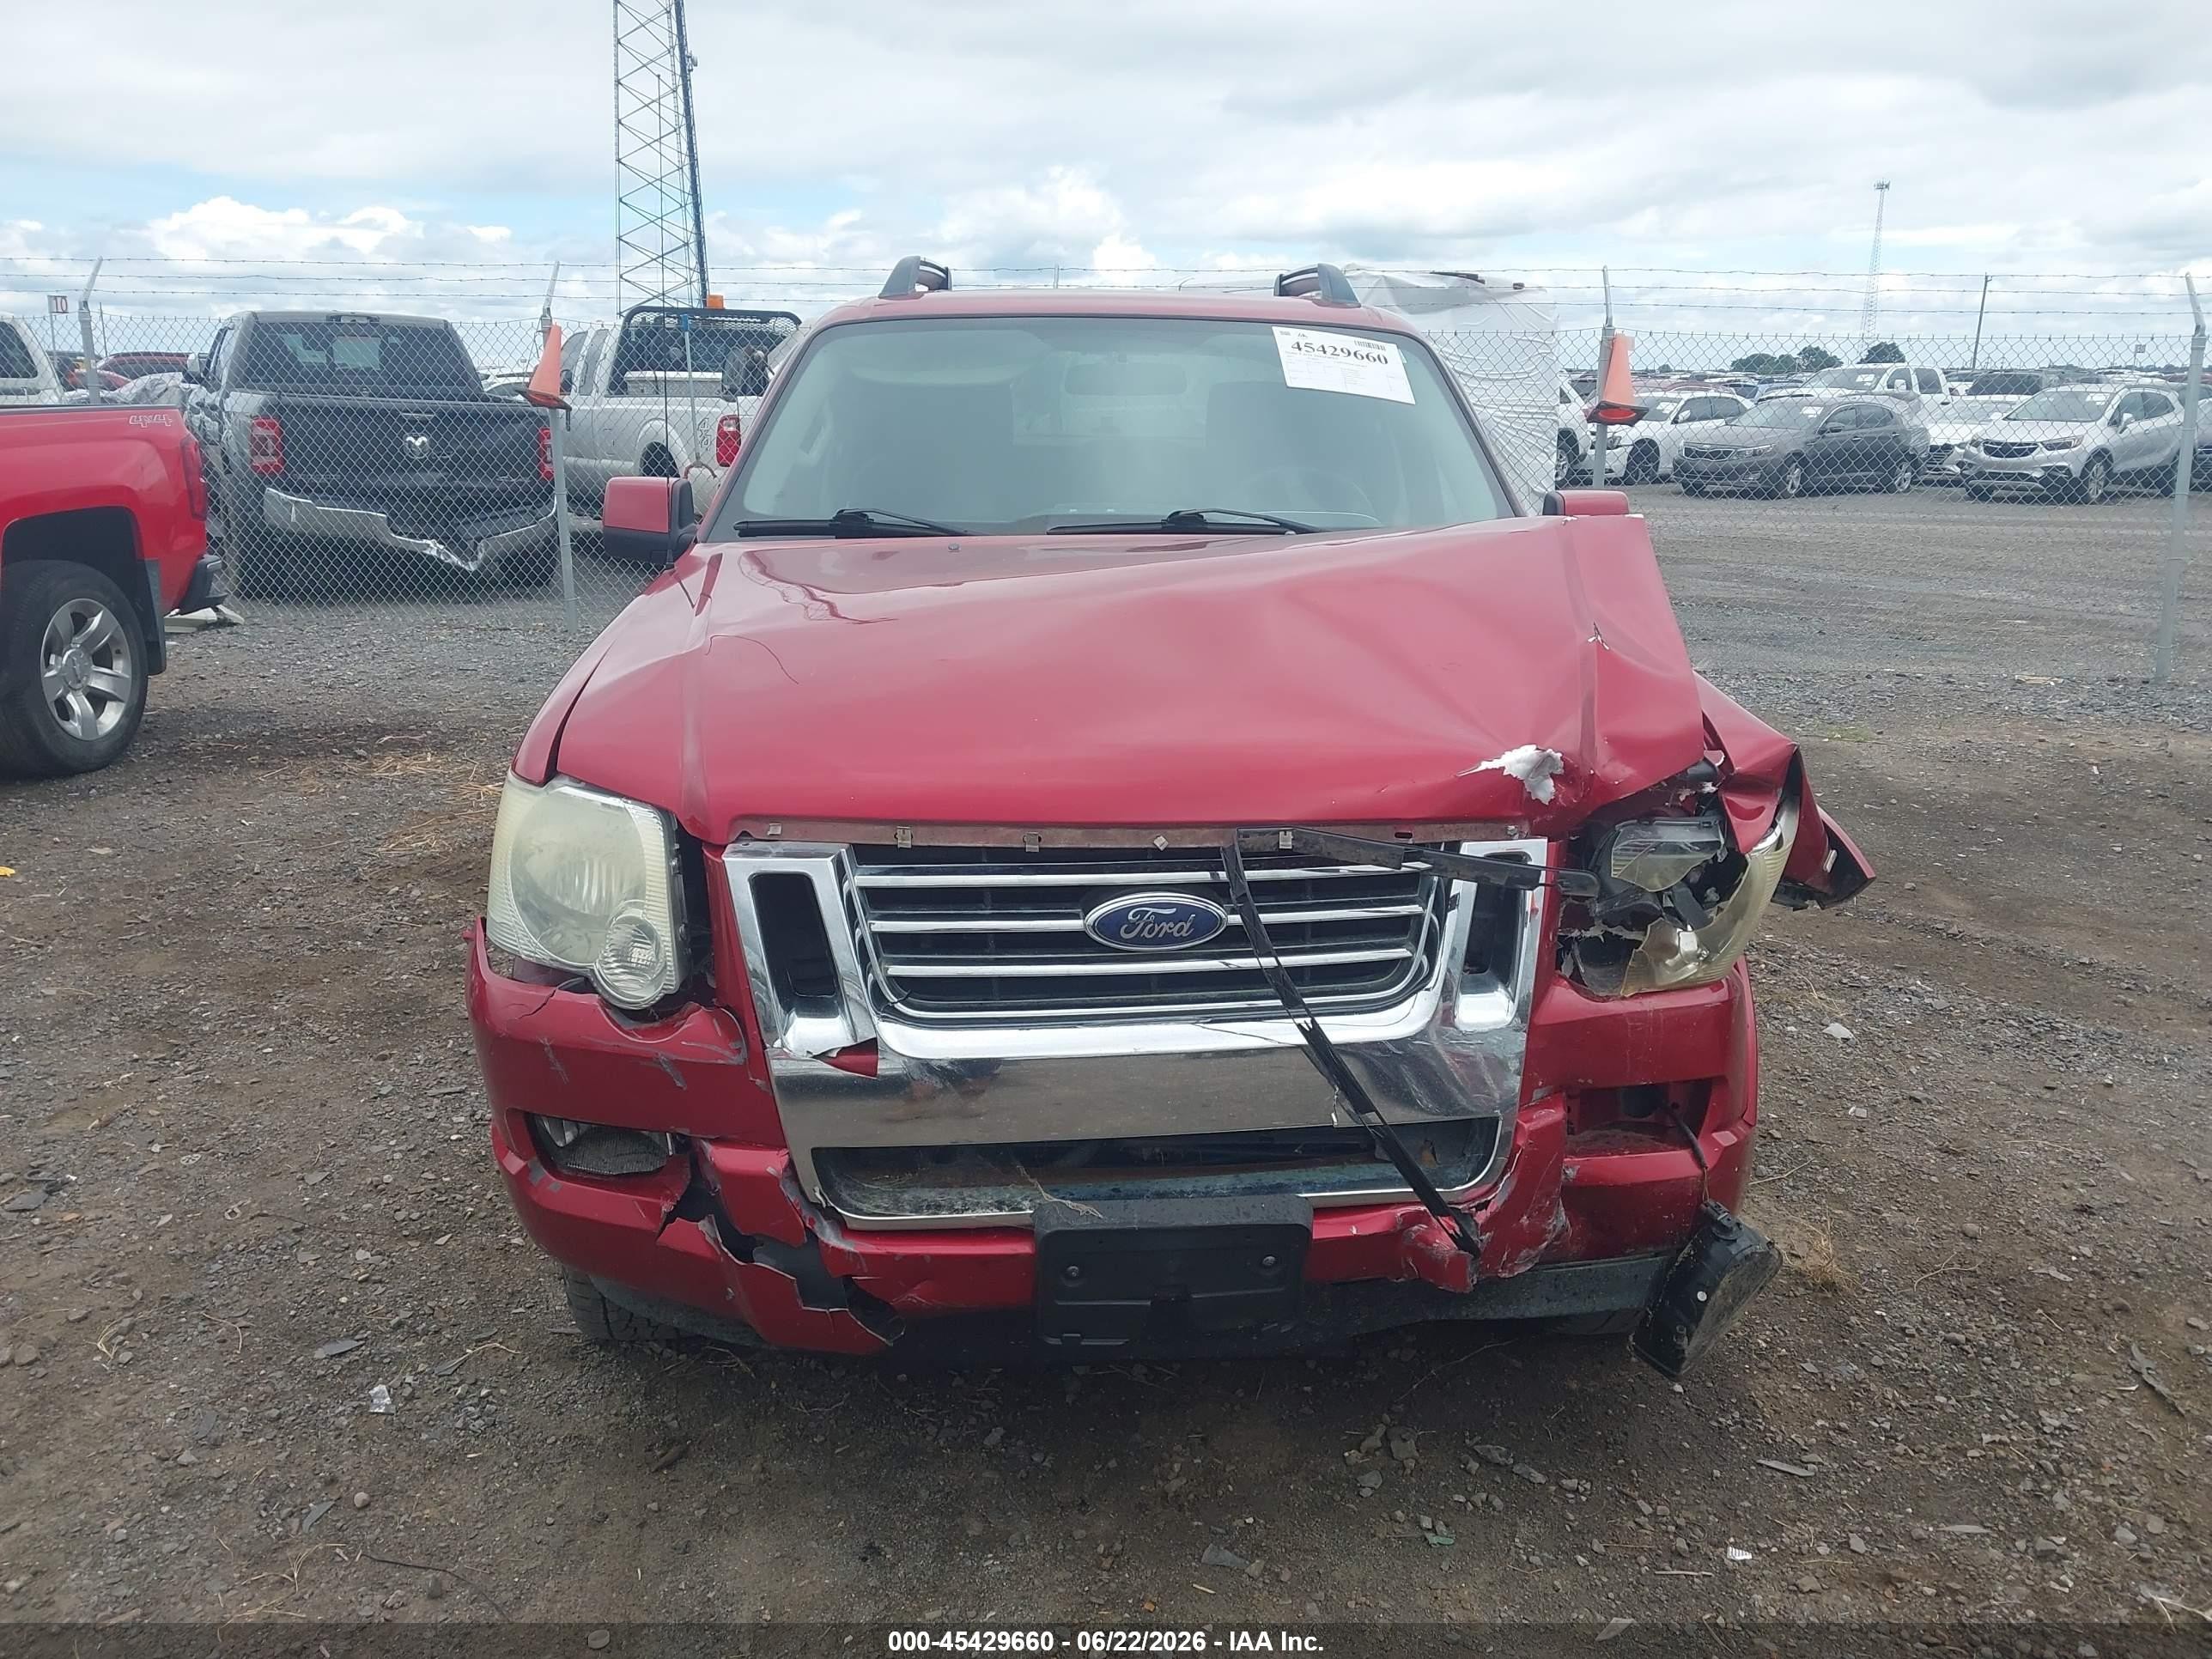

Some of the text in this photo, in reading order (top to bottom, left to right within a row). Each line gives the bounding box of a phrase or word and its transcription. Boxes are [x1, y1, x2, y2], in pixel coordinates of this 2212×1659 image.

[53, 297, 68, 312] 10
[1291, 341, 1389, 365] 45429660
[1120, 907, 1196, 939] Ford
